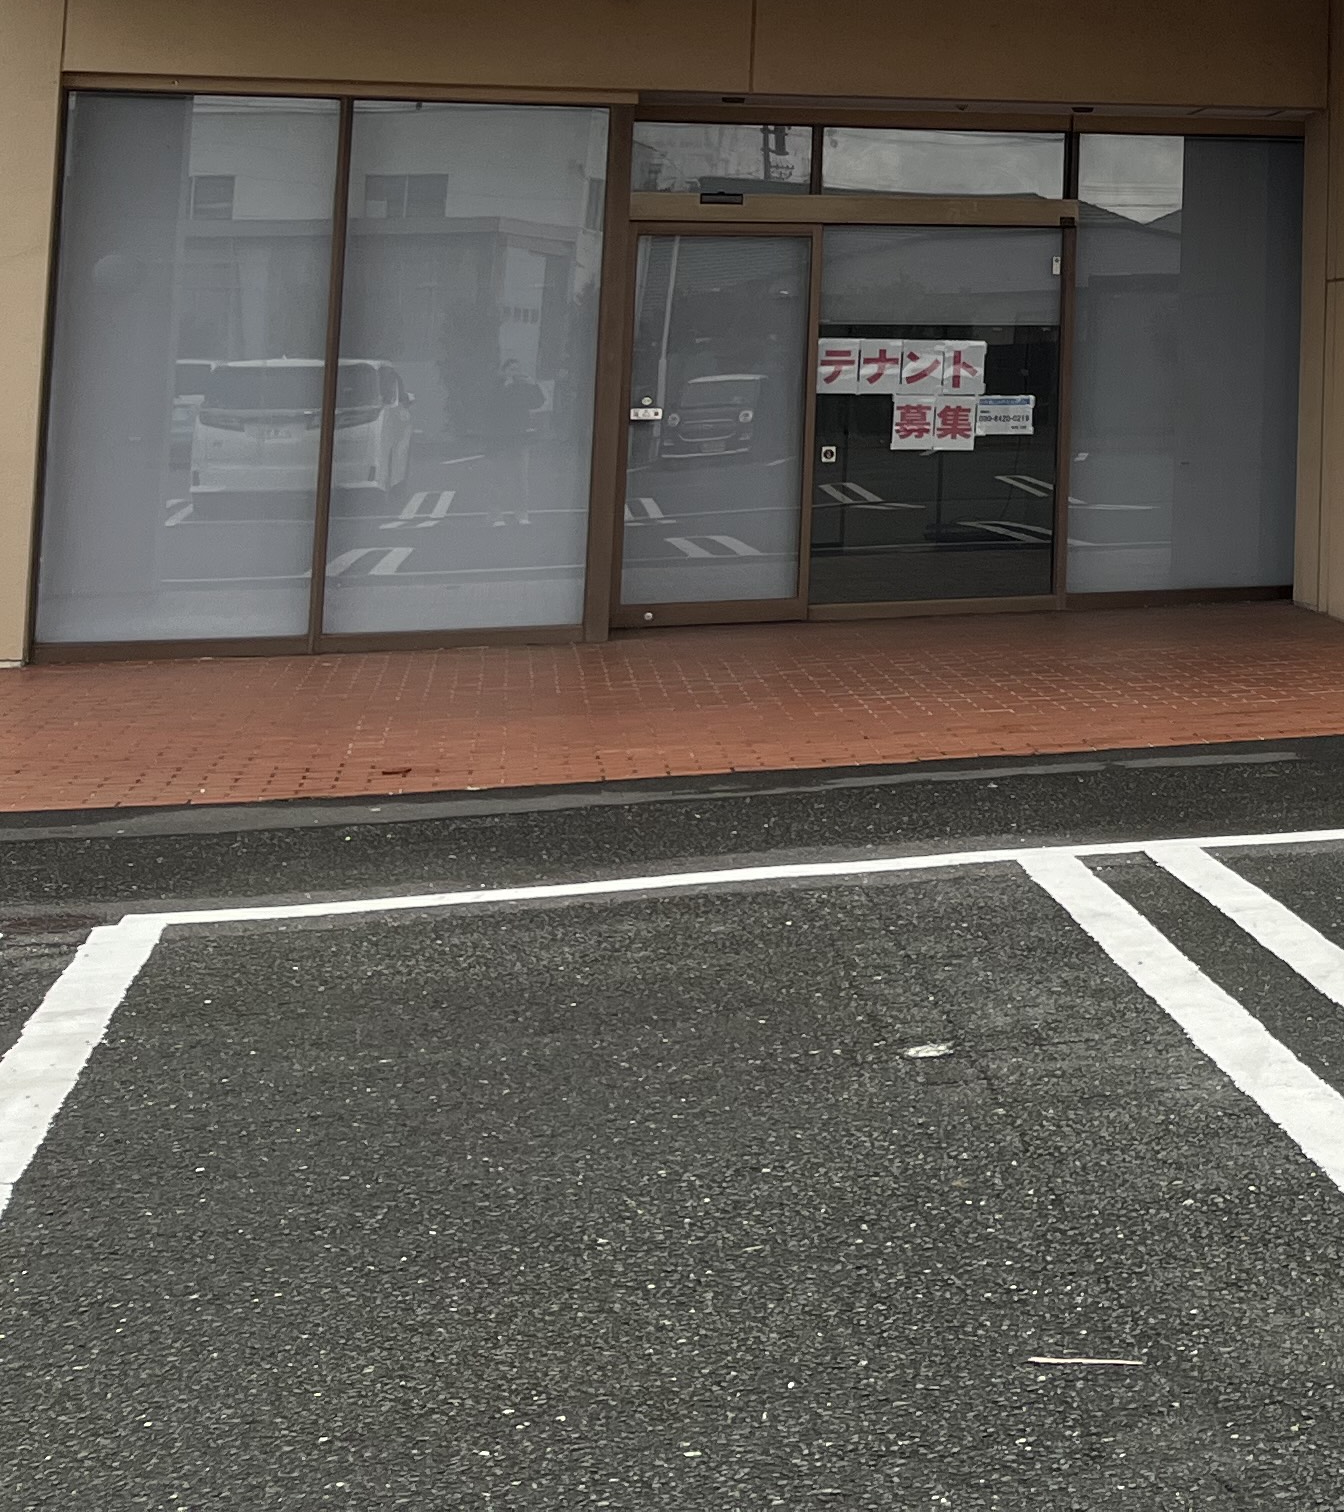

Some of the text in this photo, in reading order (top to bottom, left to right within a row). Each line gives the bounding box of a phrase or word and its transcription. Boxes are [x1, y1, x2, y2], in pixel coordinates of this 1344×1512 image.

[820, 349, 978, 388] テナント
[895, 404, 975, 439] 募集
